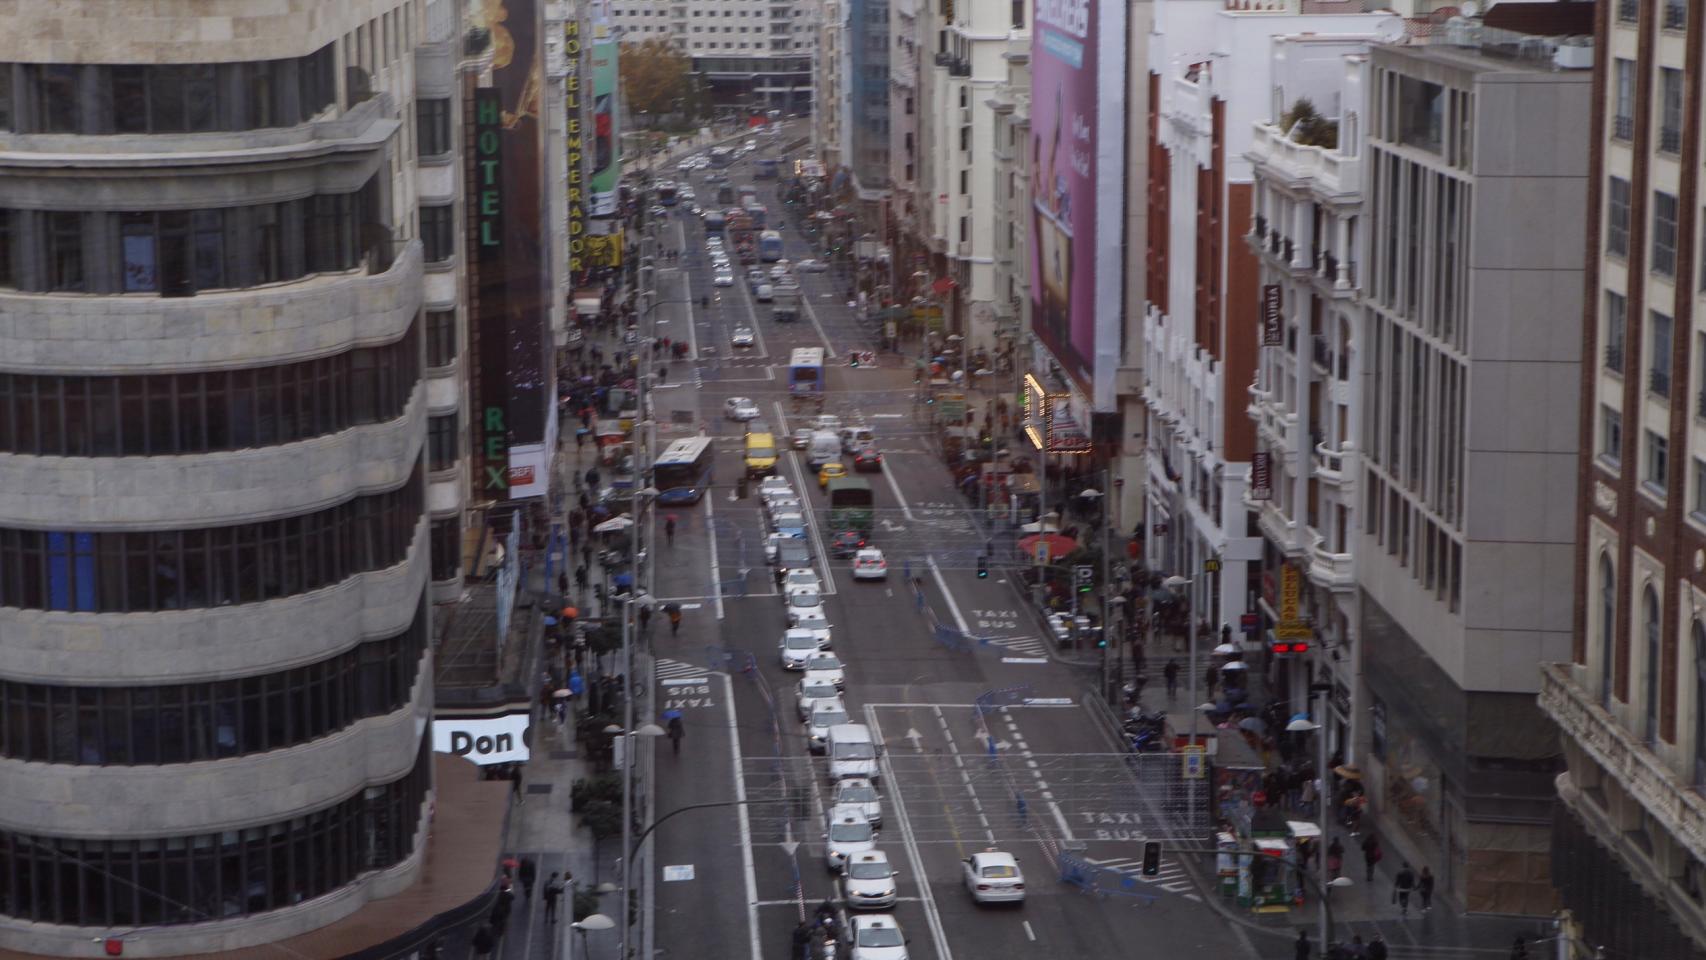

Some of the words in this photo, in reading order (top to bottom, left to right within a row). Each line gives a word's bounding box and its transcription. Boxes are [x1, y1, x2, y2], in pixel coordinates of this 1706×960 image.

[565, 21, 580, 109] HOTEL
[477, 101, 501, 247] HOTEL
[566, 120, 582, 272] EMPERADOR
[484, 407, 508, 490] REX
[971, 609, 1018, 618] TAXI
[978, 620, 1017, 628] BUS
[666, 686, 710, 696] BUS
[664, 698, 715, 709] TAXI
[451, 730, 513, 756] Don
[1080, 812, 1142, 824] TAXI
[1095, 829, 1148, 841] BUS
